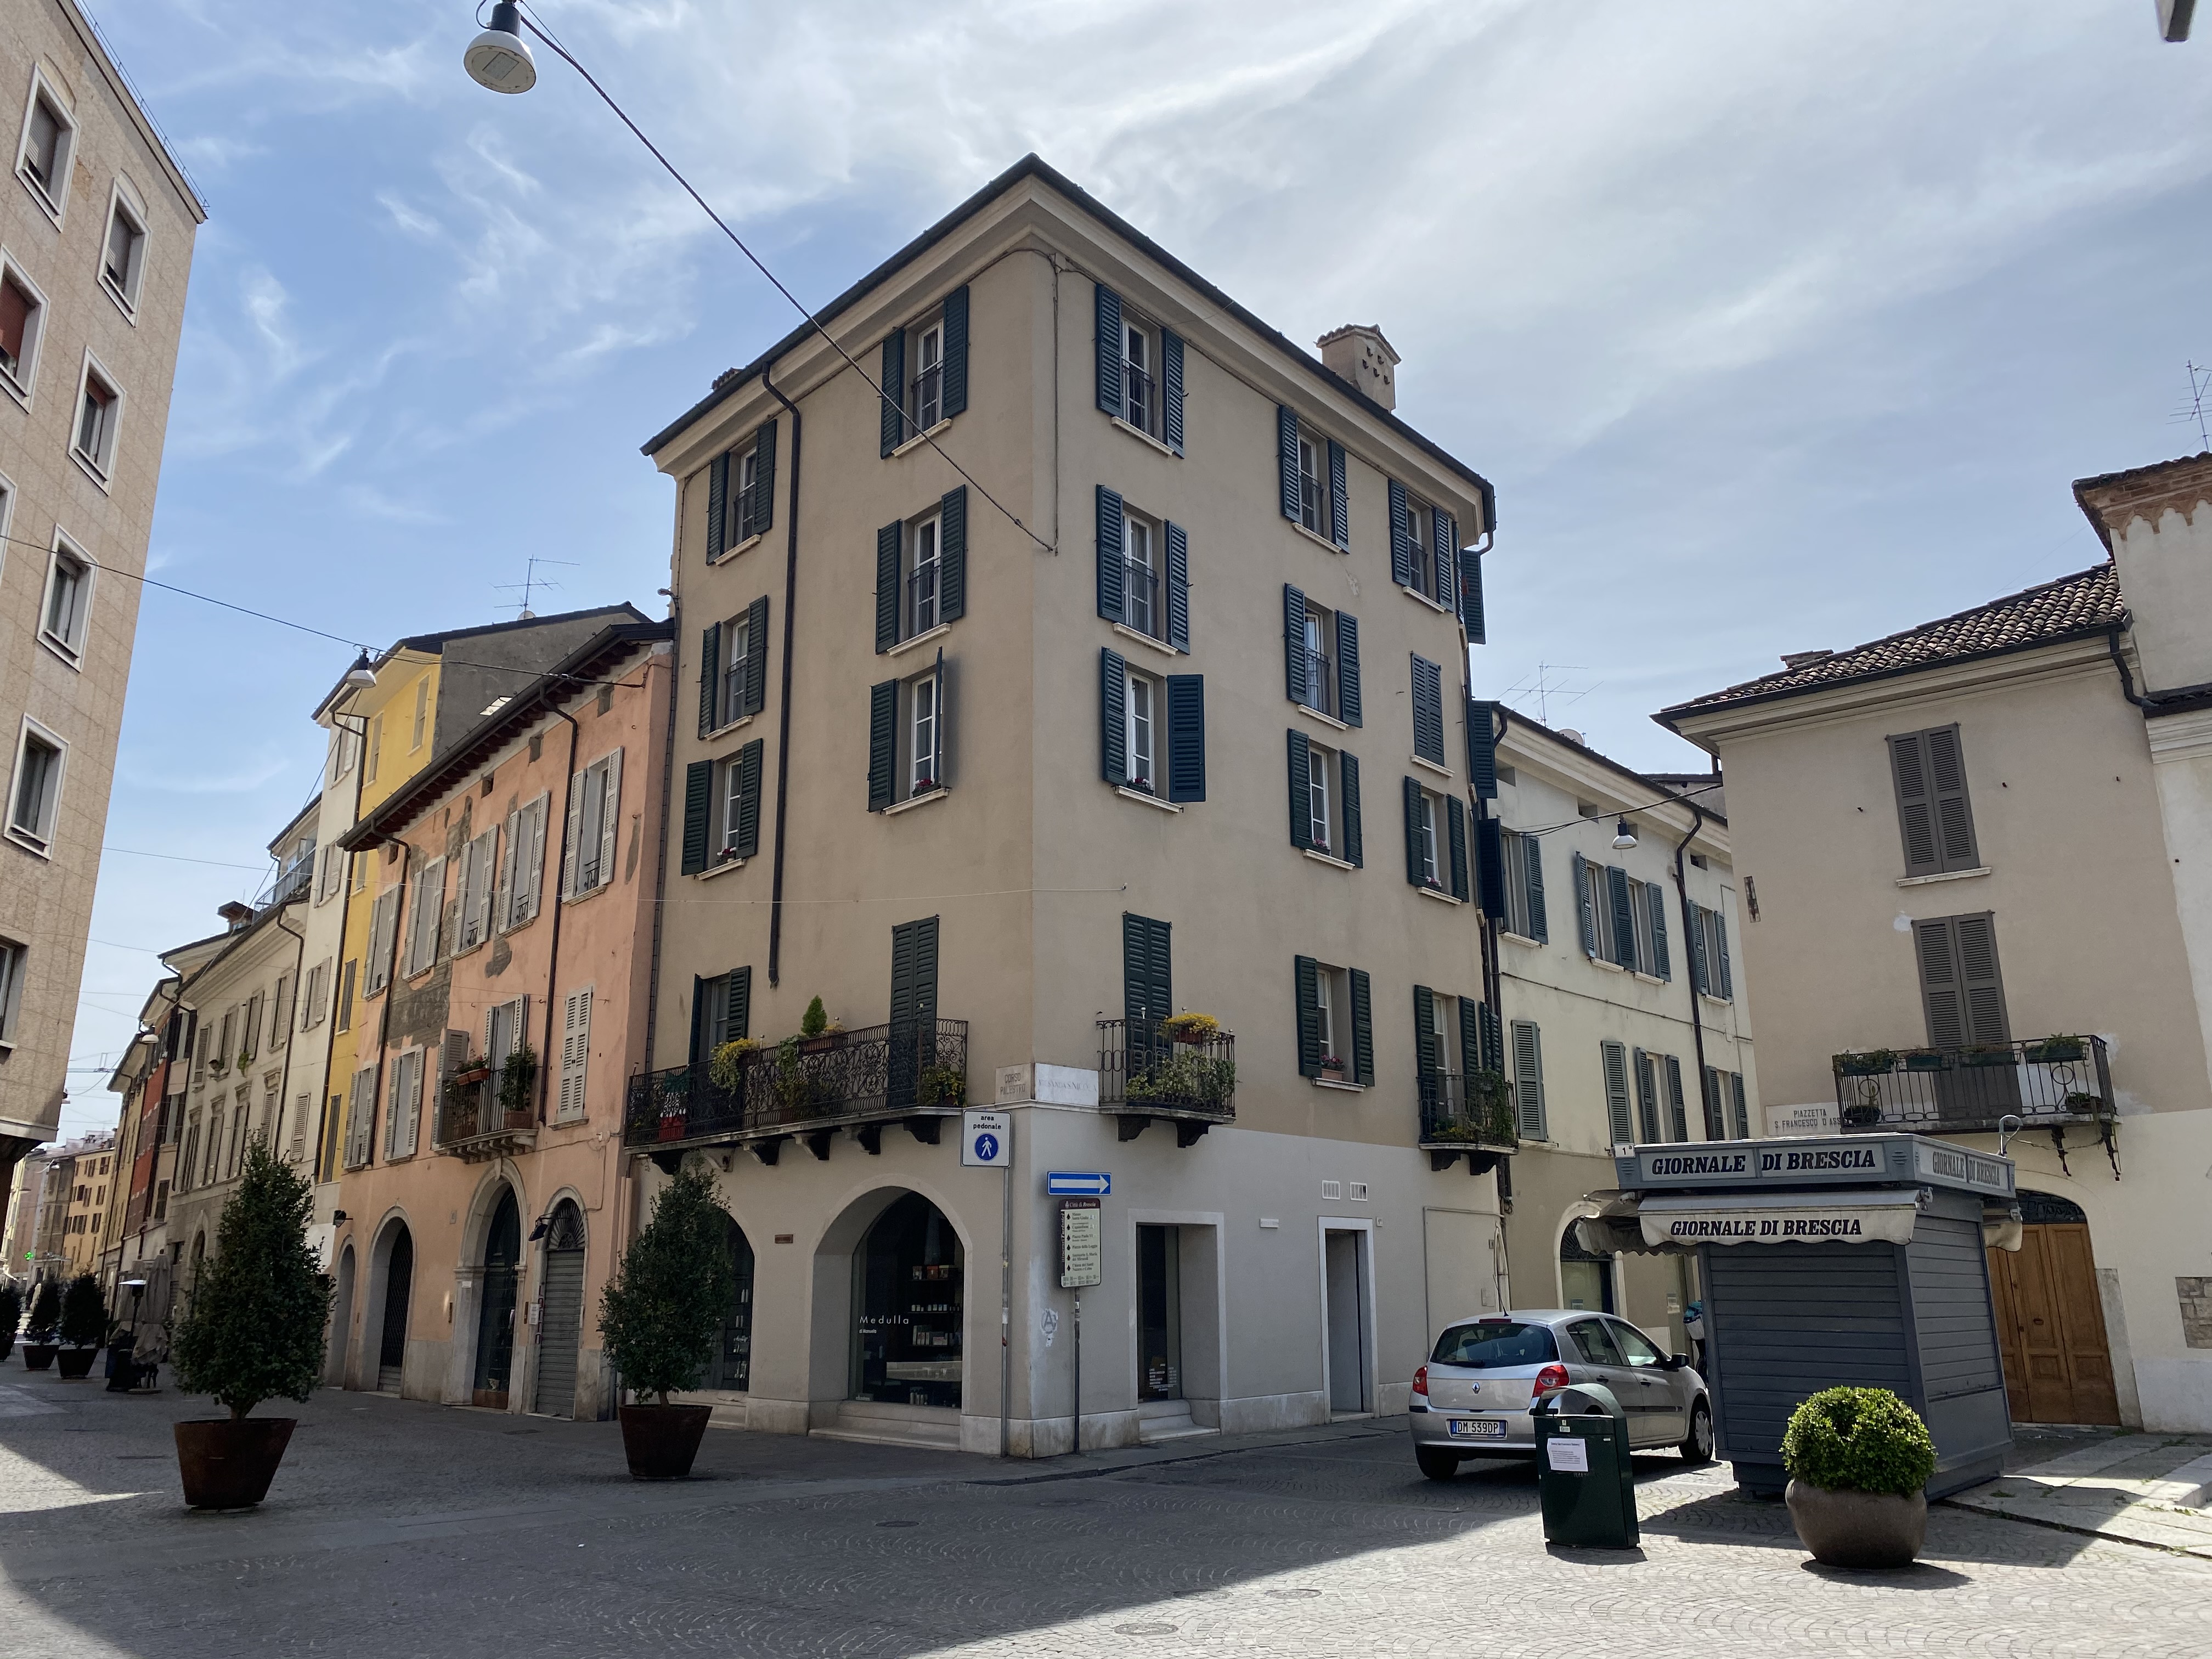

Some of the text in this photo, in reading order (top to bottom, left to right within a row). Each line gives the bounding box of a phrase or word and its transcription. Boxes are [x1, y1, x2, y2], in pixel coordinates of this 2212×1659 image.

[1005, 1073, 1021, 1083] CORSO
[1000, 1084, 1025, 1096] PALESTRO
[1793, 1108, 1827, 1119] PIAZZETTA
[1782, 1118, 1818, 1128] FRANCESCO
[1652, 1150, 1876, 1175] GIORNALE DI BRESCIA
[1933, 1151, 2000, 1186] GIORNALE DI BRESCIA
[1671, 1219, 1862, 1236] GIORNALE DI BRESCIA
[859, 1314, 909, 1324] Medulla
[1458, 1422, 1498, 1433] DM 539DP
